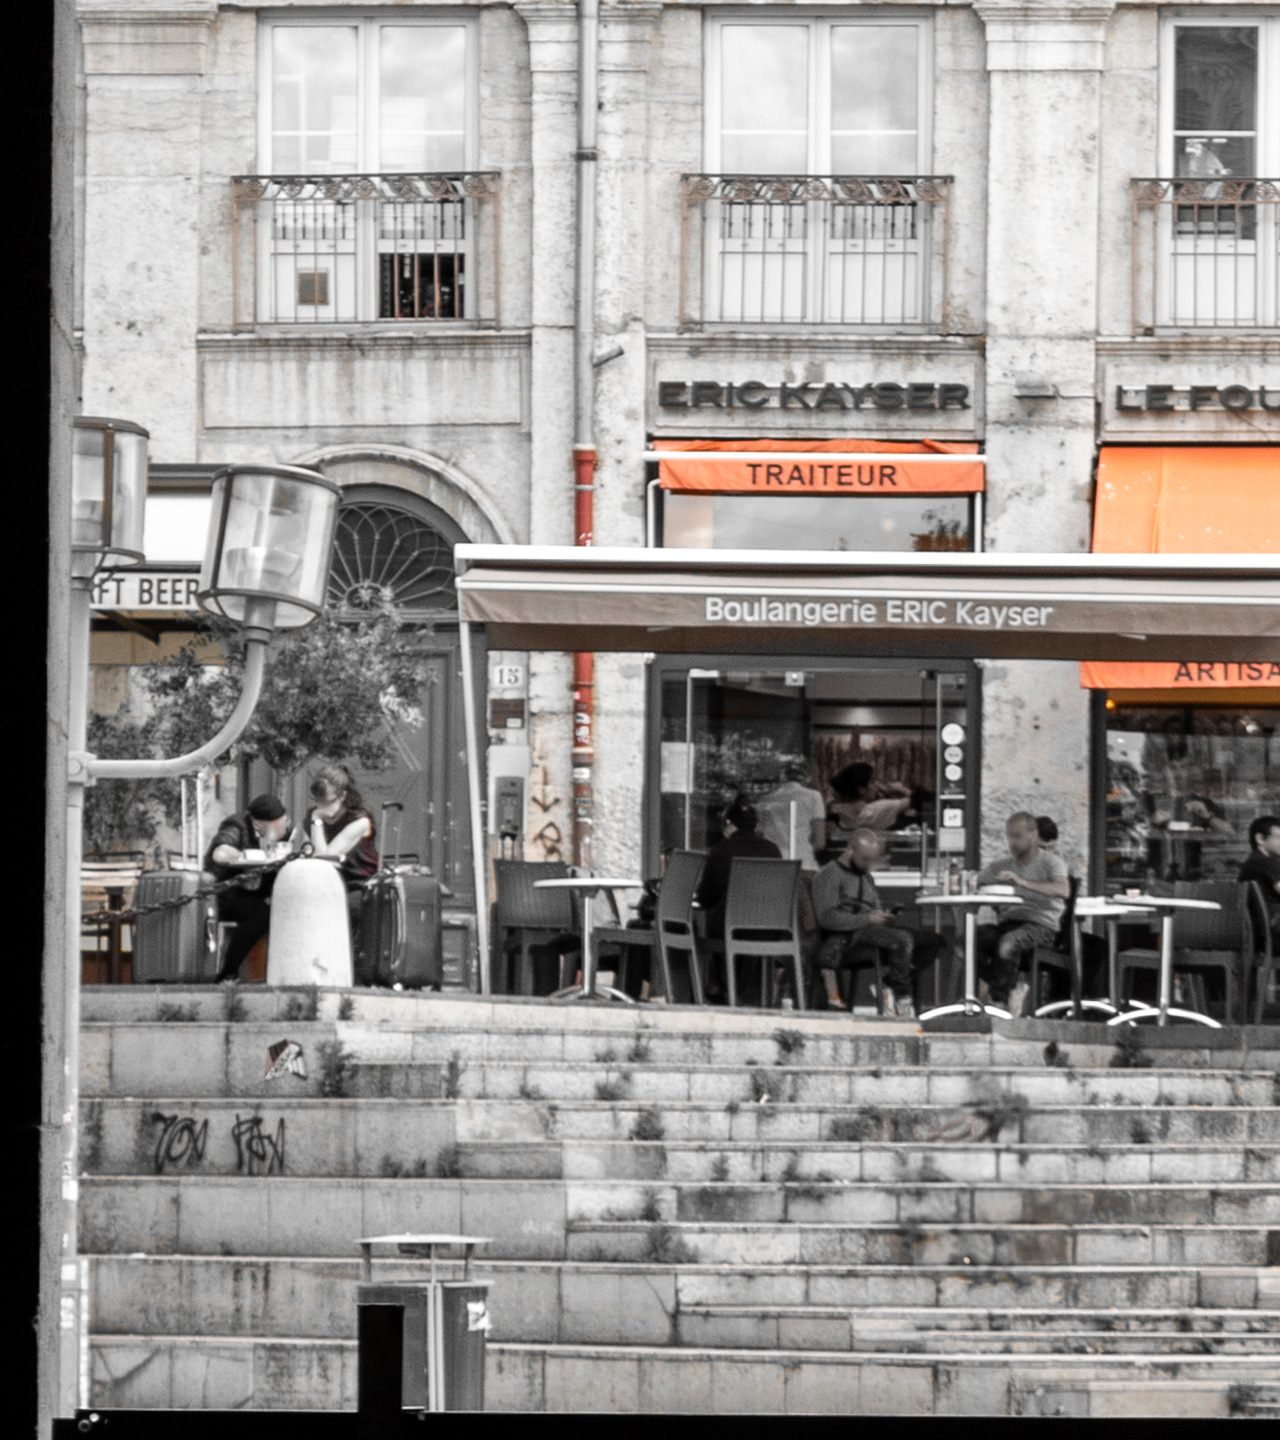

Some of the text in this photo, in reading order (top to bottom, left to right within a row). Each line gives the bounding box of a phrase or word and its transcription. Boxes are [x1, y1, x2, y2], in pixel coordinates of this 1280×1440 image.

[658, 380, 971, 410] ERIC KAYSER
[1116, 384, 1174, 411] LE
[747, 463, 897, 486] TRAITEUR
[138, 577, 200, 605] BEER
[705, 597, 1054, 630] Boulangerie ERIC Kayser
[498, 667, 519, 685] 15
